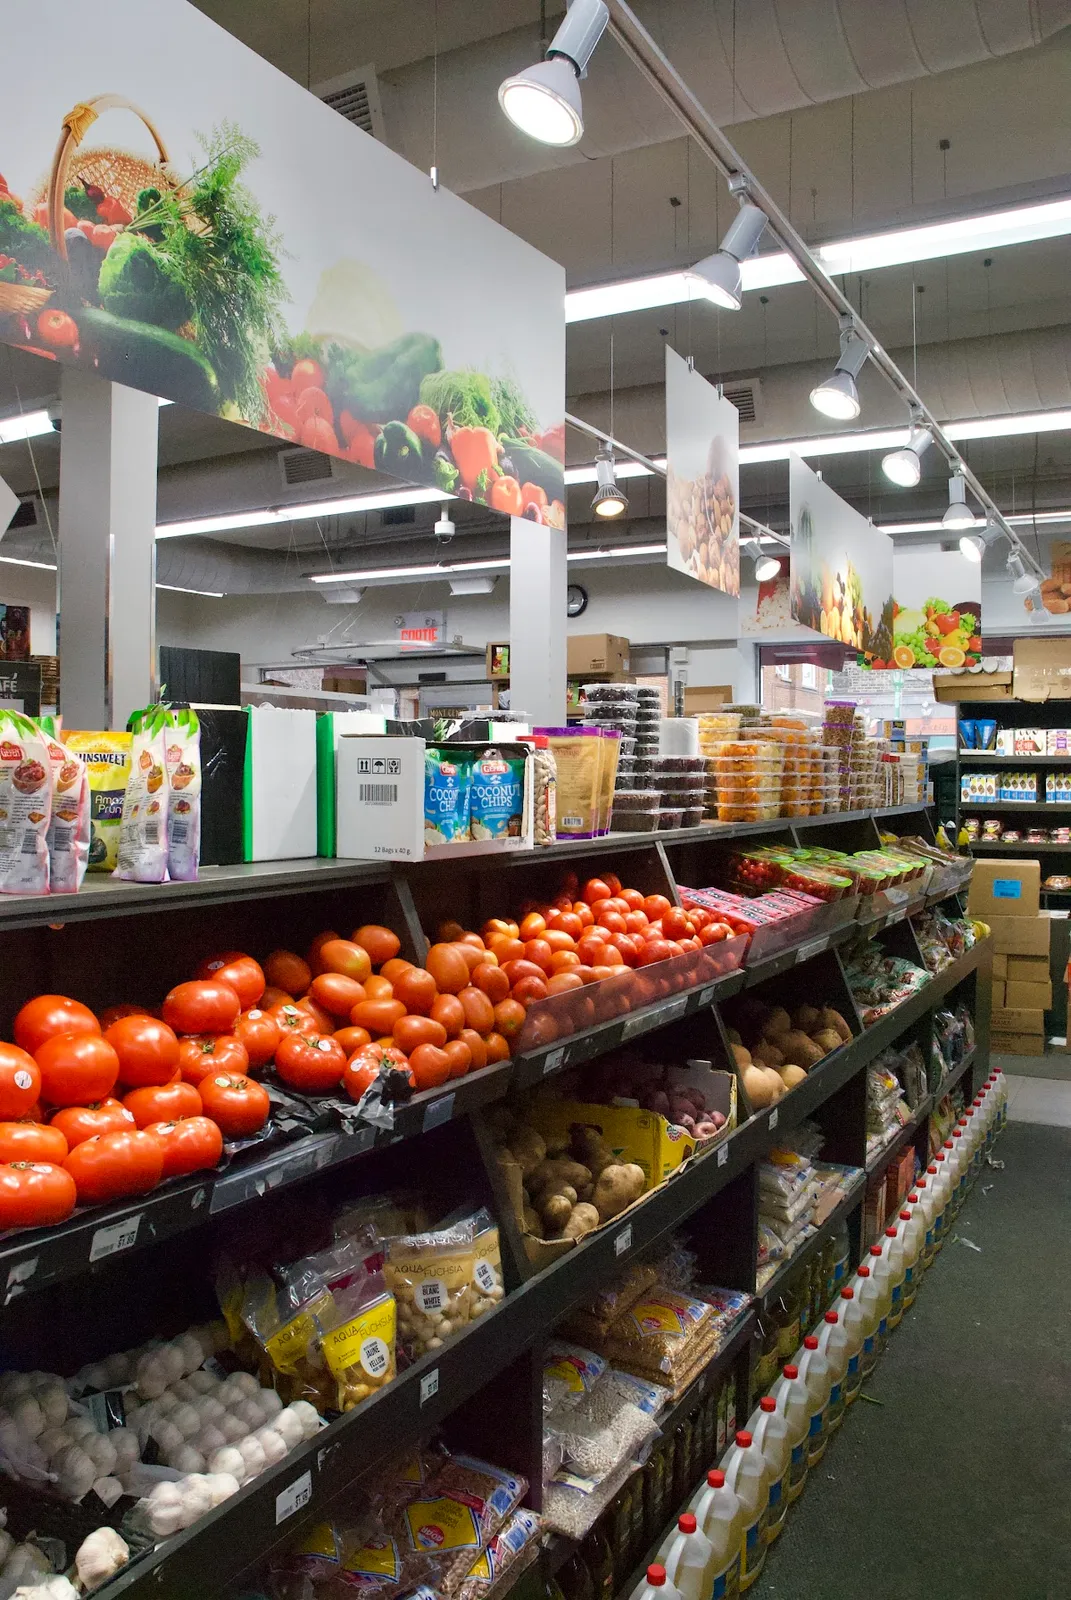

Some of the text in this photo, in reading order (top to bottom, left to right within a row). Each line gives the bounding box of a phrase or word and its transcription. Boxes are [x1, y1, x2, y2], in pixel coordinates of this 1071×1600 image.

[471, 784, 520, 799] COCONUT
[481, 796, 513, 808] CHIPS
[382, 846, 394, 855] Bags
[394, 1264, 424, 1274] AQUA
[424, 1264, 464, 1277] FUCHSIA
[422, 1287, 440, 1295] BLANC
[423, 1296, 441, 1306] WHITE
[333, 1326, 359, 1345] AQUA
[359, 1314, 393, 1338] FUCHSIA
[369, 1354, 385, 1368] YELLOW
